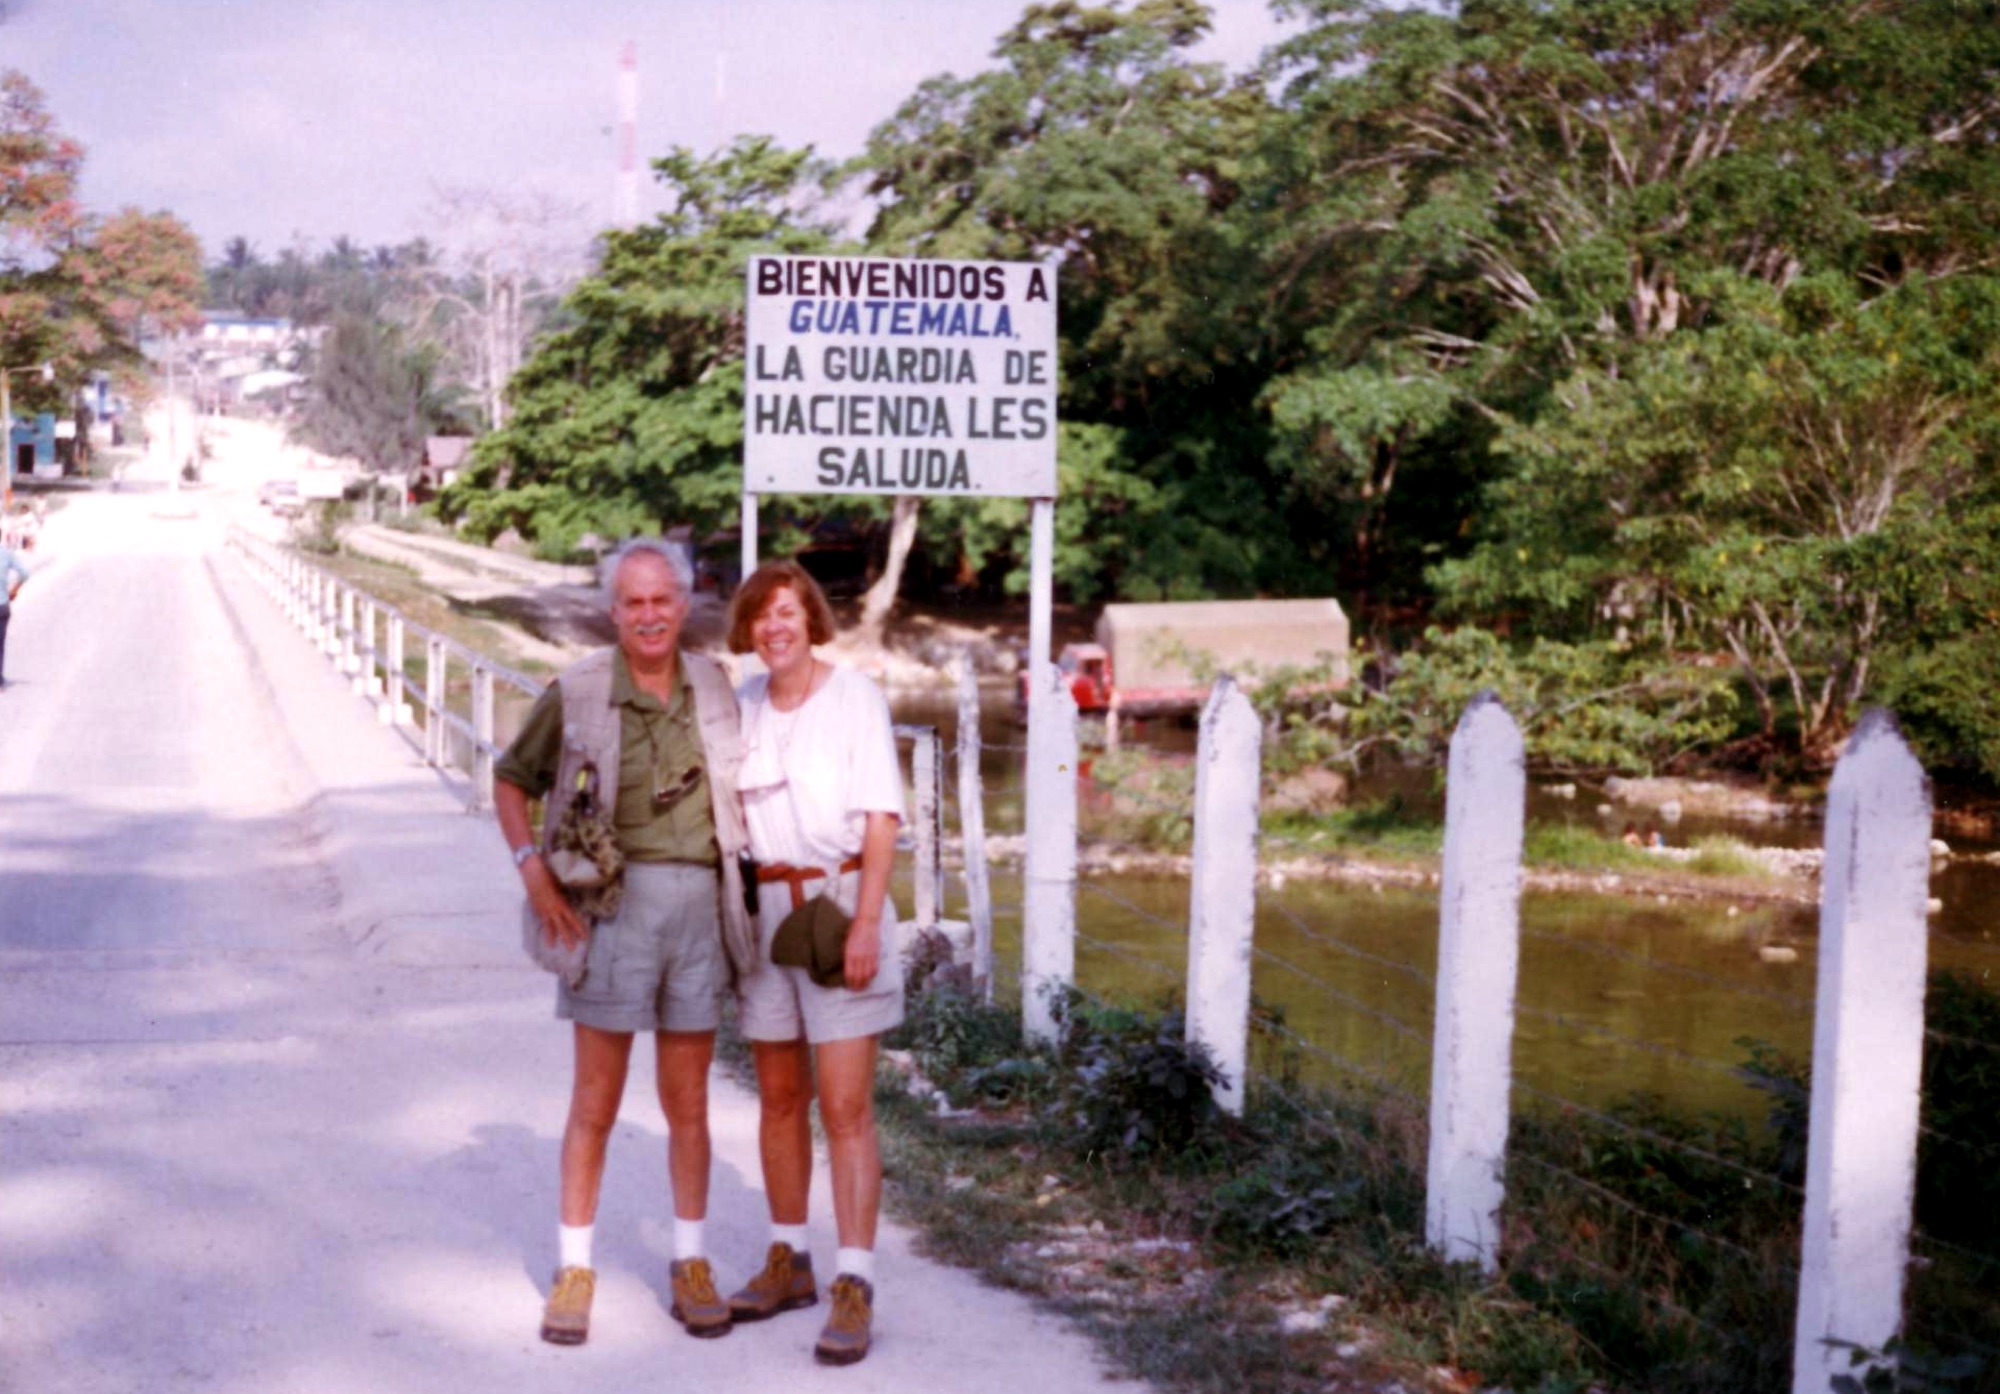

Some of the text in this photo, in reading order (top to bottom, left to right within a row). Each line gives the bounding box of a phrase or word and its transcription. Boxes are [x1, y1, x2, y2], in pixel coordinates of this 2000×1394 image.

[757, 259, 1048, 301] BIENVENIDOS A
[755, 345, 1047, 385] LA GUARDIA DE
[755, 394, 1048, 440] HACIENDA LES
